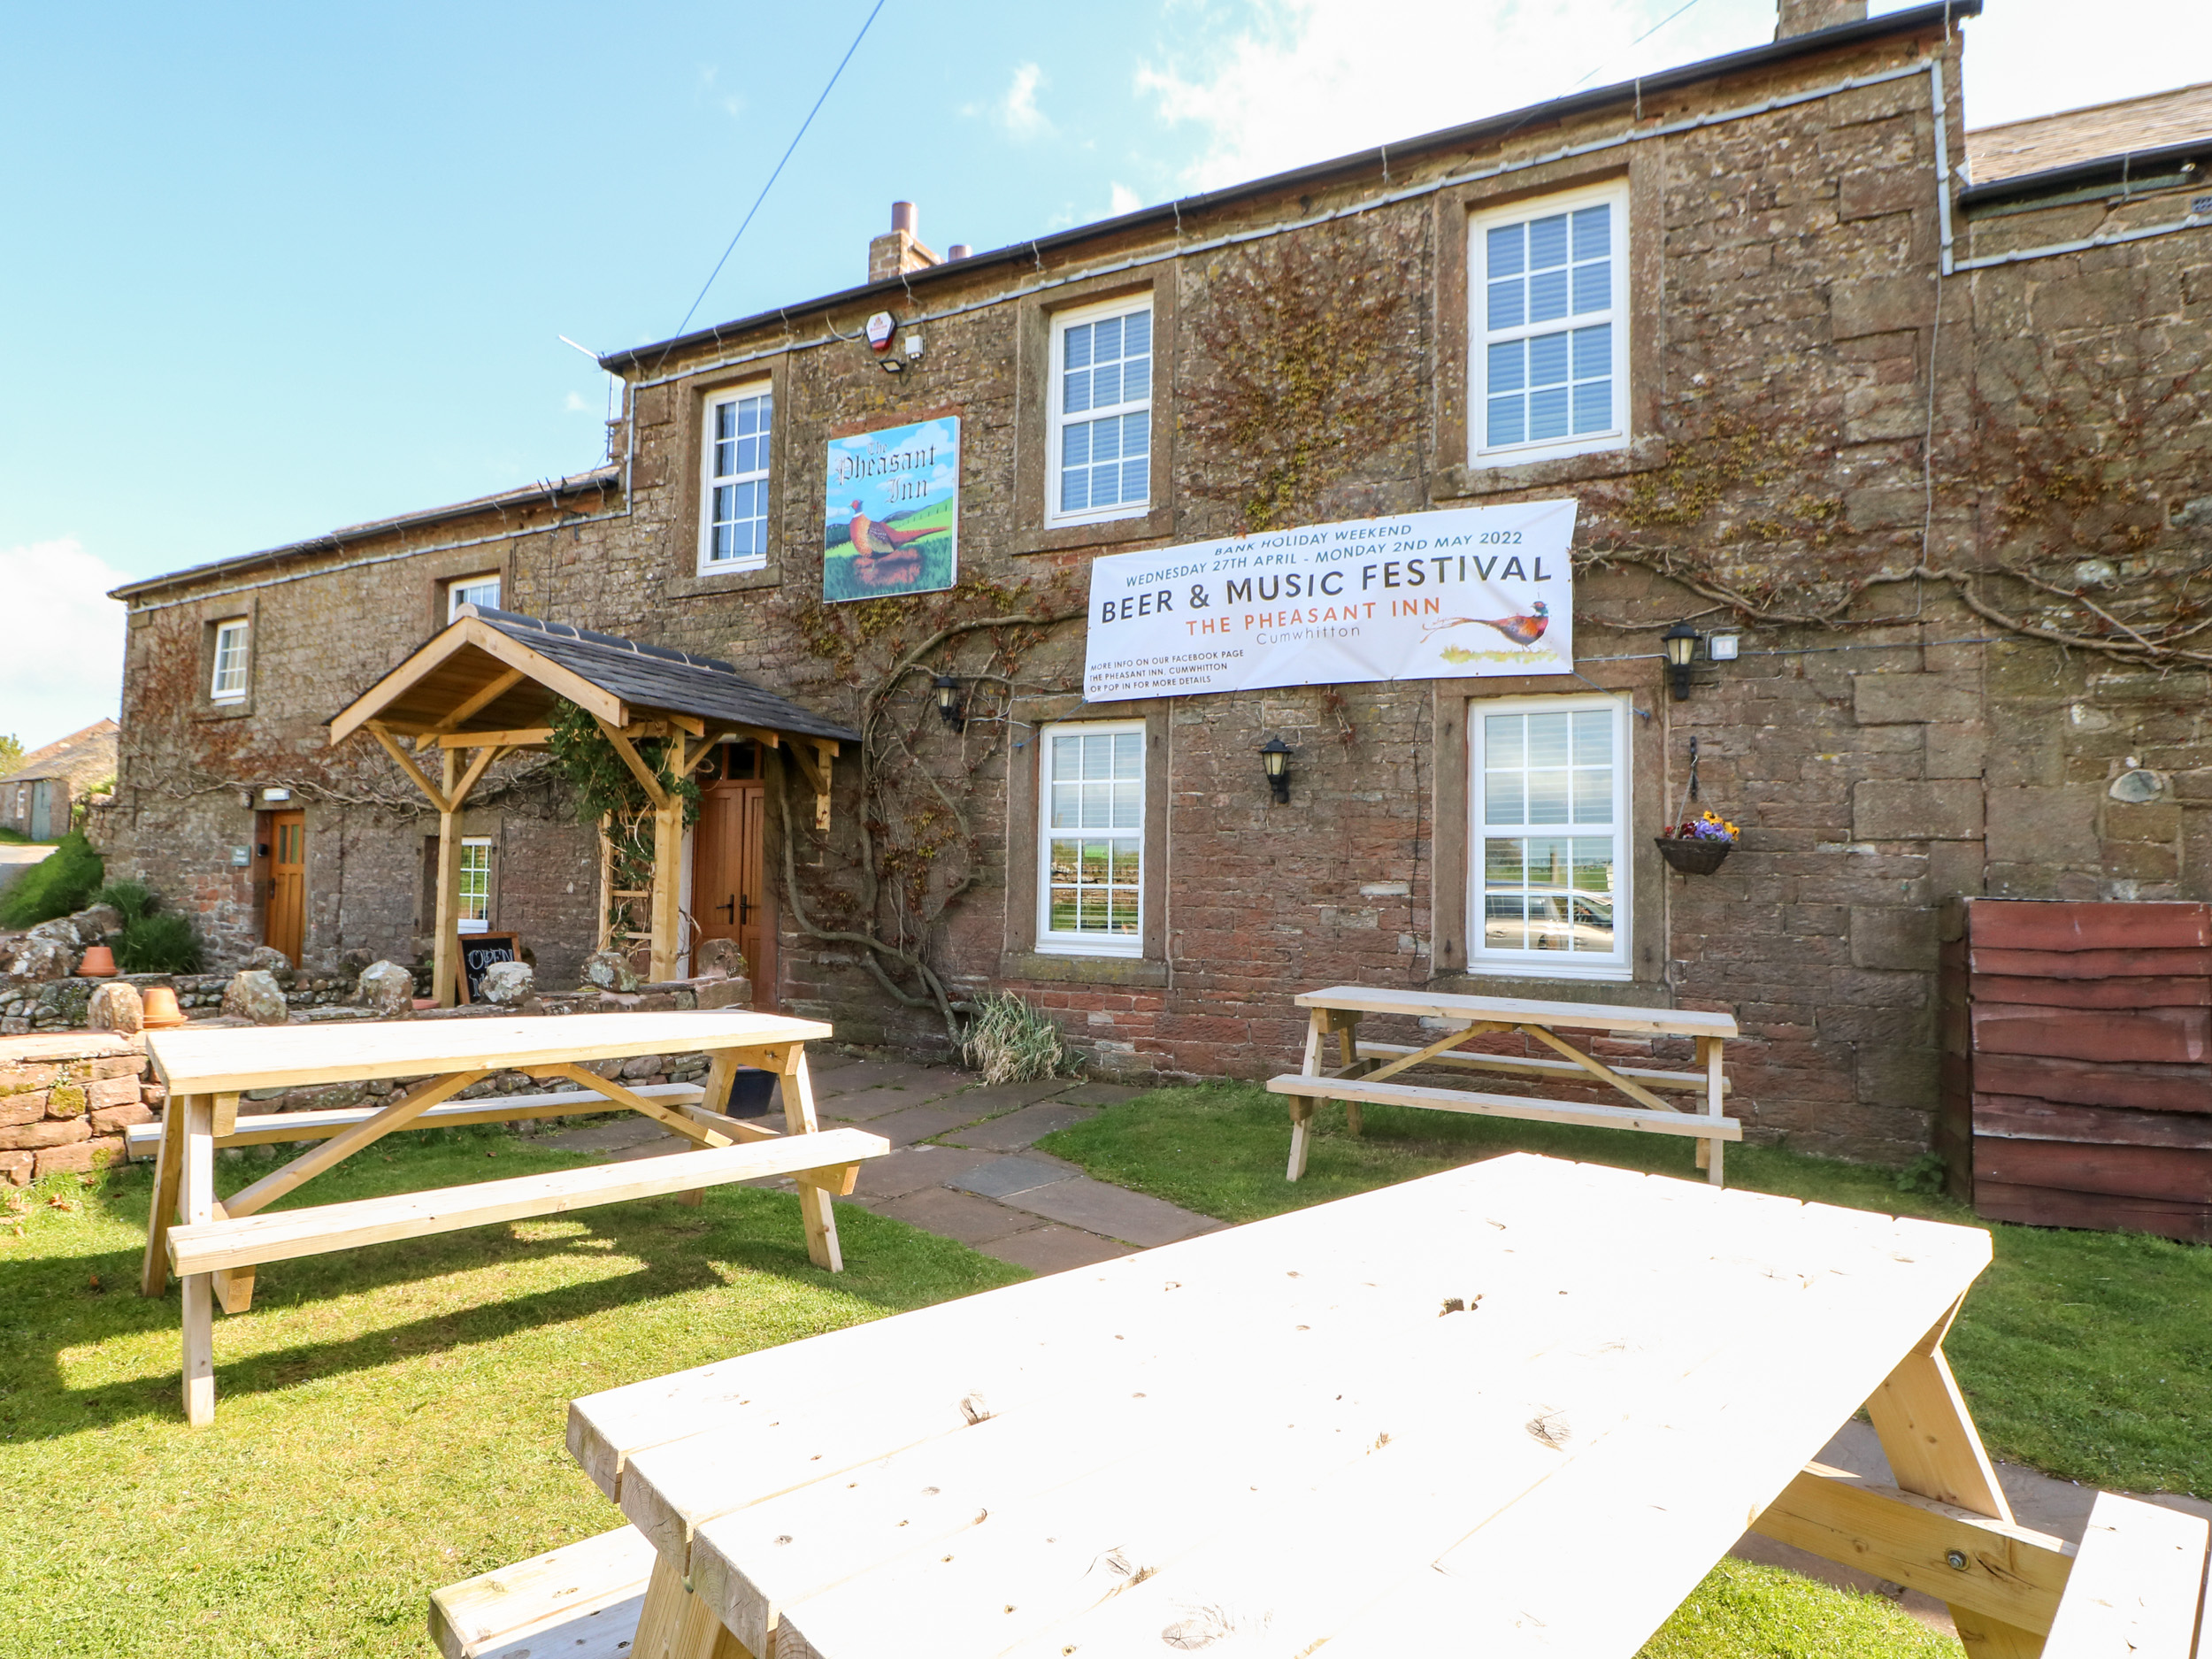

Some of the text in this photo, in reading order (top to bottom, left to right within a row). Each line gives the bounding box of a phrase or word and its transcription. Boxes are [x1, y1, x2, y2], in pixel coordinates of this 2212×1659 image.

[867, 442, 887, 456] The
[833, 443, 936, 486] Pheasant
[885, 477, 927, 503] Inn
[1215, 525, 1411, 556] BANK HOLIDAY WEEKEND
[1126, 562, 1208, 588] WEDNESDAY
[1212, 557, 1247, 572] 27TH
[1254, 555, 1296, 567] APRIL
[1315, 543, 1386, 564] MONDAY
[1393, 539, 1427, 552] 2ND
[1434, 534, 1472, 549] MAY
[1479, 532, 1523, 545] 2022
[1102, 556, 1552, 624] BEER & MUSIC FESTIVAL
[1186, 597, 1440, 636] THE PHEASANT INN
[1256, 625, 1360, 646] Cumwhitton
[1090, 662, 1112, 672] MORE
[1114, 659, 1133, 668] INFO
[1172, 651, 1218, 663] FACEBOOK
[1221, 649, 1244, 658] PAGE
[1105, 671, 1146, 680] PHEASANT
[1169, 663, 1228, 675] CUMWHITTON
[1090, 684, 1102, 693] OR
[1104, 683, 1119, 692] POP
[1133, 680, 1149, 689] FOR
[1152, 679, 1177, 687] MORE
[1179, 675, 1211, 685] DETAILS
